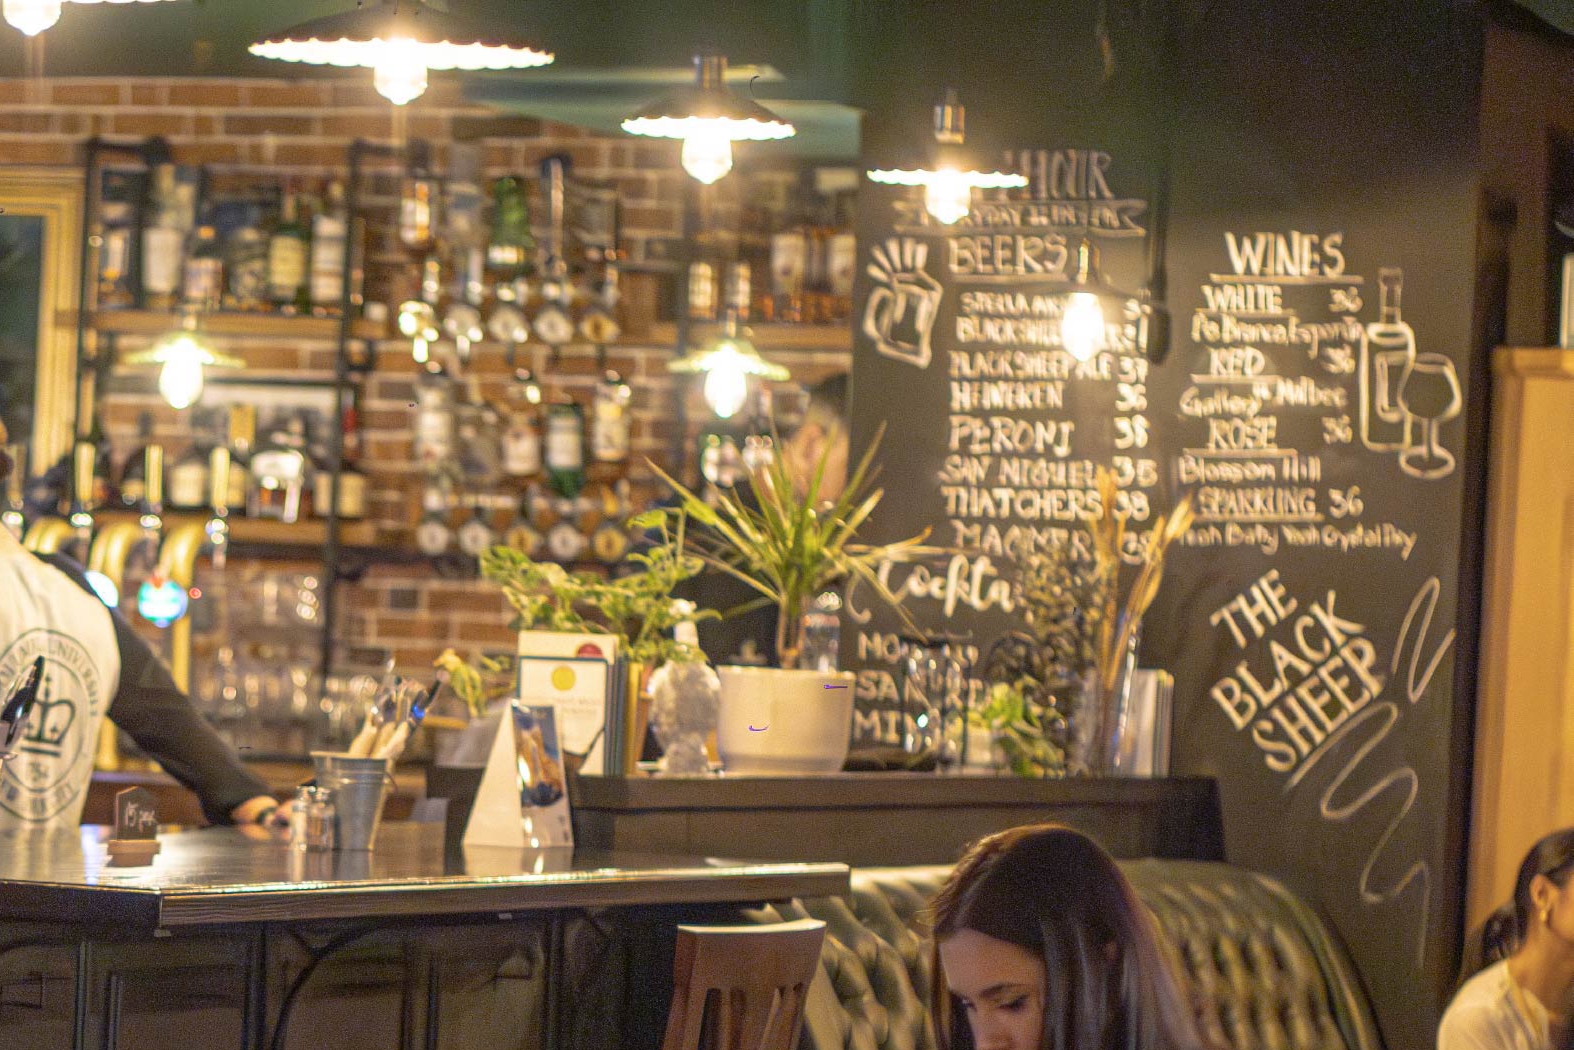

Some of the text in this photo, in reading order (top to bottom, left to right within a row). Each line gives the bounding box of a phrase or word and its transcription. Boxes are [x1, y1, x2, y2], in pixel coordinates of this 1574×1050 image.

[949, 234, 1068, 274] BEERS
[1225, 231, 1346, 278] WINES
[1201, 284, 1283, 314] WHITE
[956, 316, 1018, 343] BLACK
[948, 350, 1014, 379] BLACK
[1206, 346, 1265, 376] RED
[951, 380, 1148, 412] HEINEKEN 36
[949, 414, 1075, 457] PERONI
[938, 454, 993, 486] SAN
[940, 486, 1104, 522] THATCHERS
[1198, 485, 1364, 519] SPARKLING 36
[1209, 569, 1298, 649] THE
[1210, 590, 1365, 731] BLACK
[1252, 637, 1385, 773] SHEEP
